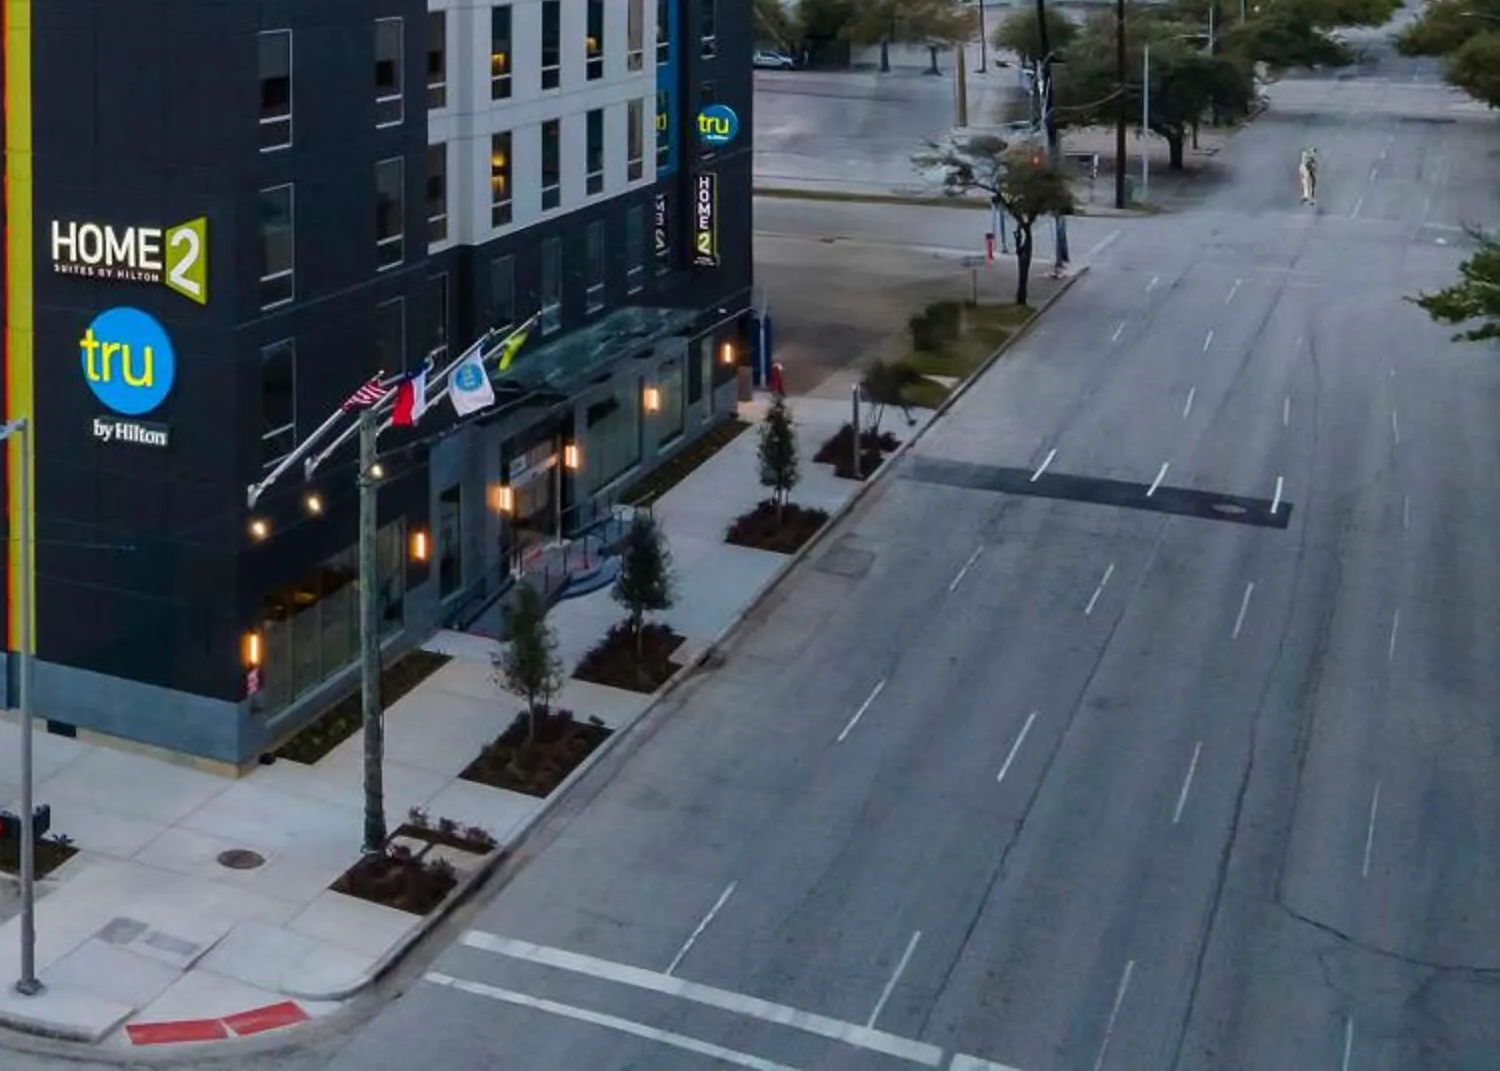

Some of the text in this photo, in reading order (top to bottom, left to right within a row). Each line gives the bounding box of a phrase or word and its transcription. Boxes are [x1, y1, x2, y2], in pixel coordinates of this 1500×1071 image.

[697, 112, 729, 134] tru
[53, 263, 94, 276] SUITES
[117, 269, 159, 282] HILTON
[79, 328, 153, 387] tru
[93, 418, 168, 446] by Hilton
